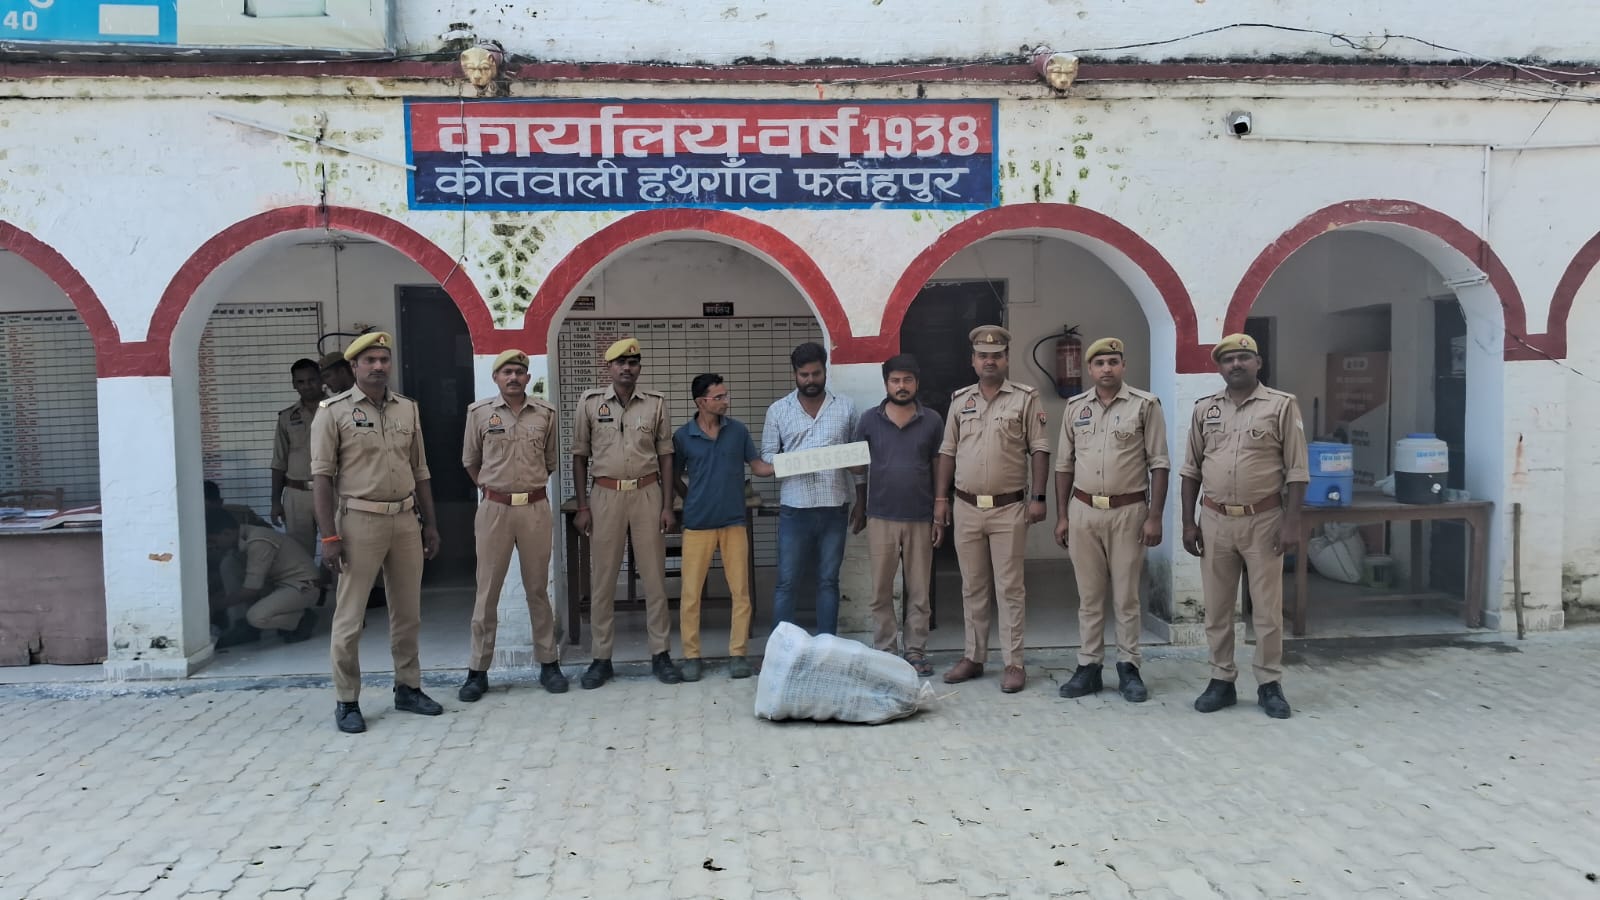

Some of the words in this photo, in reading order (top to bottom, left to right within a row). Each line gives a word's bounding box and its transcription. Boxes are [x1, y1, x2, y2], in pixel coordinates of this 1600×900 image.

[3, 11, 38, 30] 40
[863, 114, 979, 158] 1938
[434, 159, 628, 199] कोतवाली
[637, 159, 783, 202] हथगाँव
[793, 161, 970, 201] फतेहपुर
